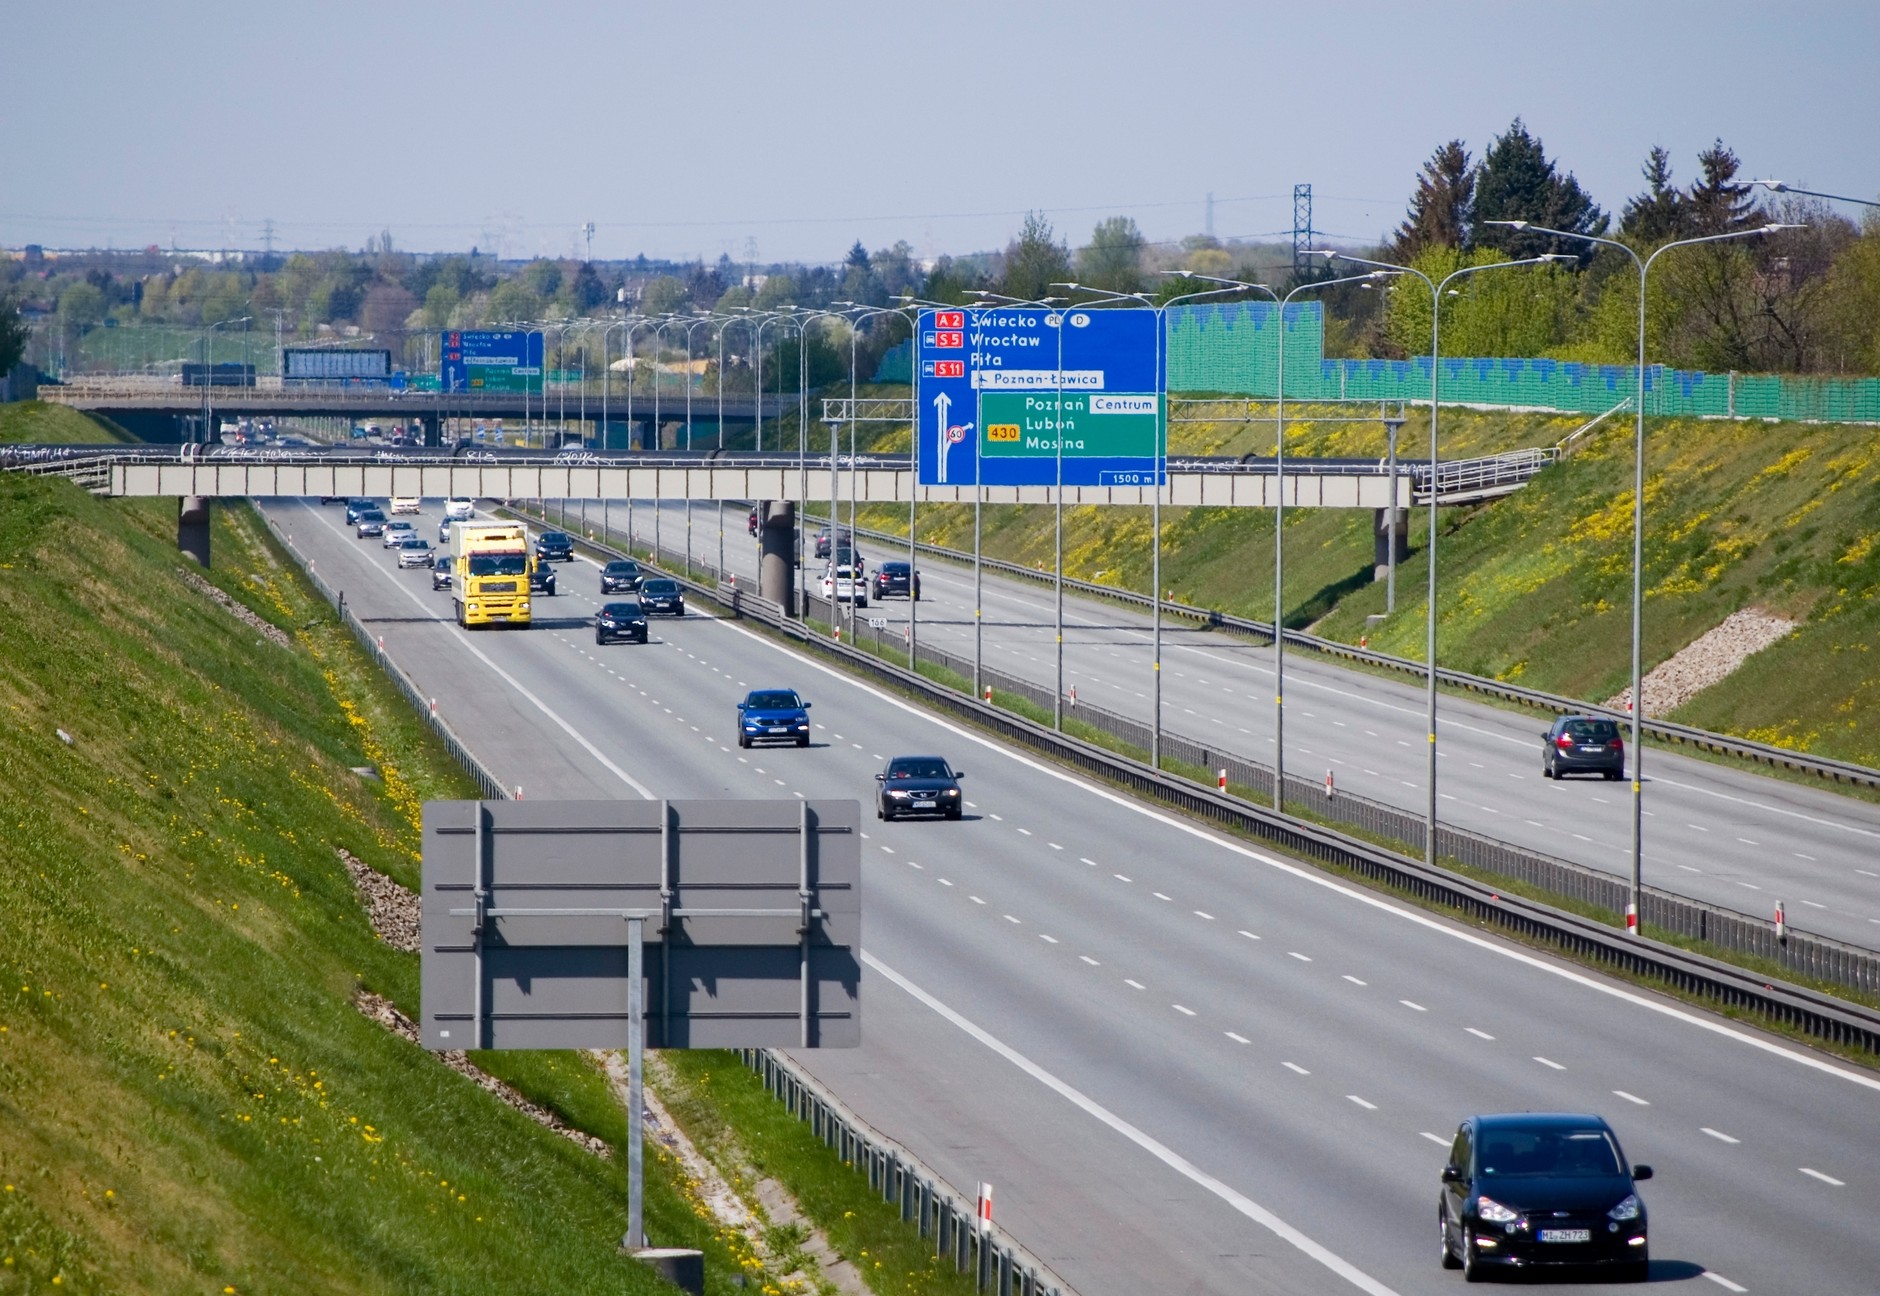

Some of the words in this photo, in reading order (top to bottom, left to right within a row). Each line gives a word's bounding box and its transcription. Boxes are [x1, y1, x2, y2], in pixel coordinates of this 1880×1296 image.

[970, 309, 1037, 327] Świecko
[1049, 316, 1060, 325] PL
[1076, 315, 1084, 325] D
[970, 333, 1040, 347] Wrocław
[970, 353, 1002, 366] Piła
[1026, 396, 1084, 410] Poznań
[1095, 398, 1152, 410] Centrum
[1026, 416, 1075, 430] Luboń
[951, 430, 962, 438] 60
[991, 427, 1017, 439] 430
[1026, 436, 1085, 449] Mosina
[1113, 474, 1139, 484] 1500
[1144, 476, 1152, 484] m
